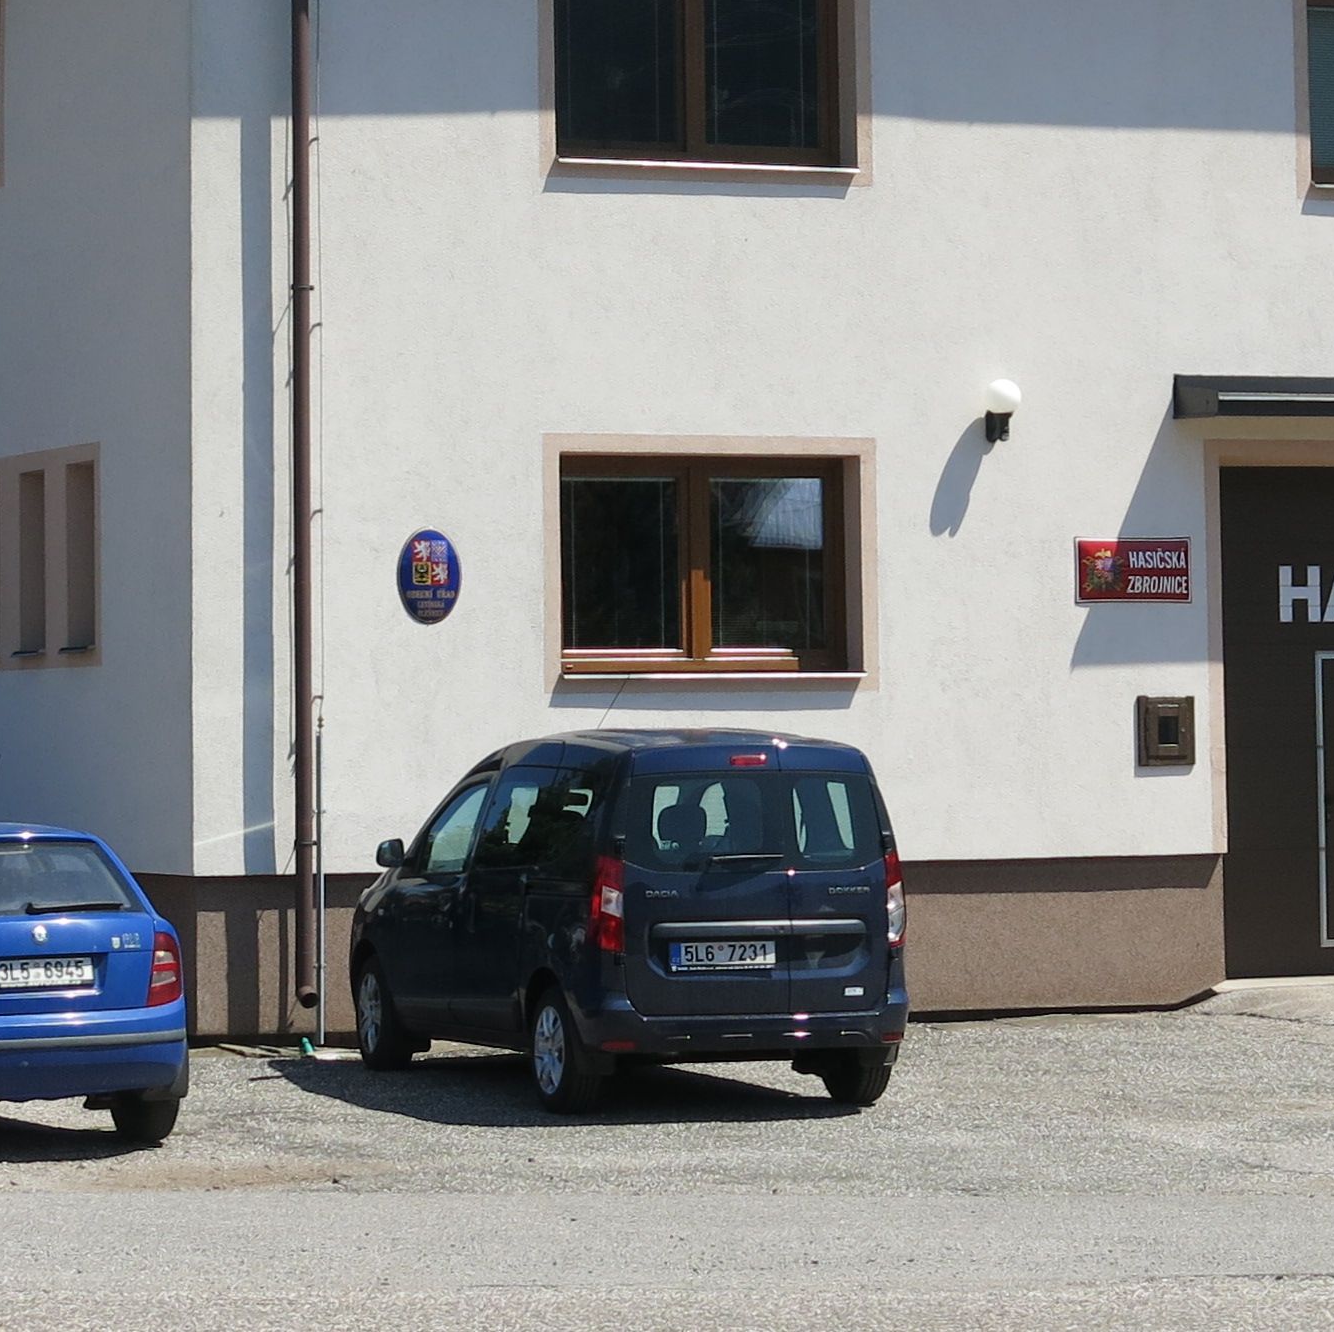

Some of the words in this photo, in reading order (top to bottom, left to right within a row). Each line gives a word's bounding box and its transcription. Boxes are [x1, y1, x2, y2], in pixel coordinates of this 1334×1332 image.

[1128, 548, 1186, 569] HASIČSKÁ
[1127, 575, 1188, 594] ZBROJNICE
[645, 889, 679, 899] DACIA
[828, 886, 871, 895] DOKKER
[684, 944, 715, 963] 5L6
[727, 943, 768, 962] 7231
[43, 959, 86, 979] 6945
